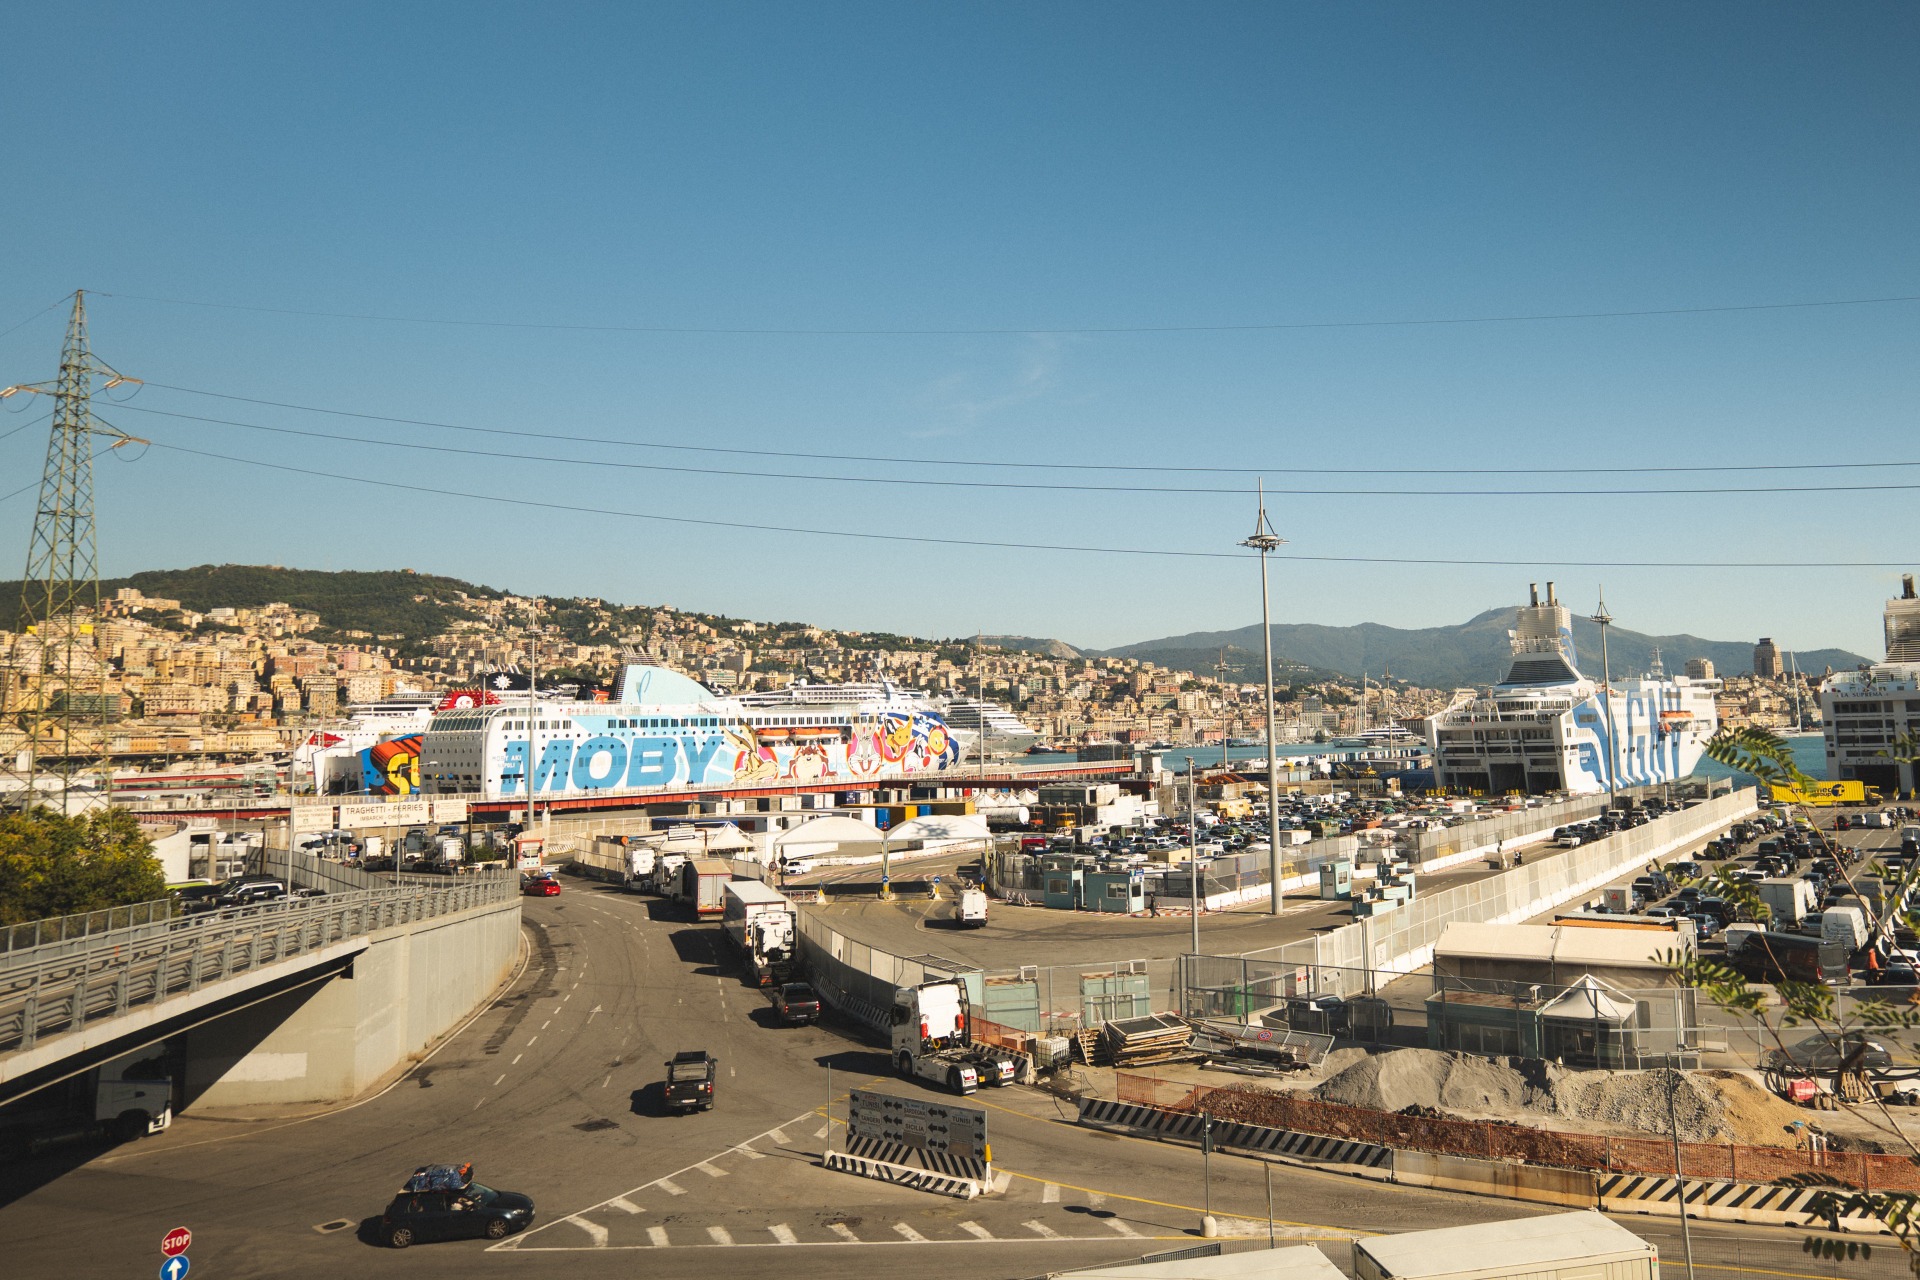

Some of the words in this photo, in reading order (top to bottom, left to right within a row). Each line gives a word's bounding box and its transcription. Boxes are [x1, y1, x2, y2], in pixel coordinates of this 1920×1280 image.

[500, 735, 725, 797] MOBY
[346, 805, 386, 815] TRAGHETTI
[393, 803, 424, 812] FERRIES
[861, 1100, 880, 1110] TUNISI
[903, 1107, 926, 1116] SARDEGNA
[861, 1115, 880, 1124] TANGERI
[952, 1115, 971, 1125] TUNISI
[905, 1123, 924, 1133] SICILIA
[164, 1234, 190, 1250] STOP
